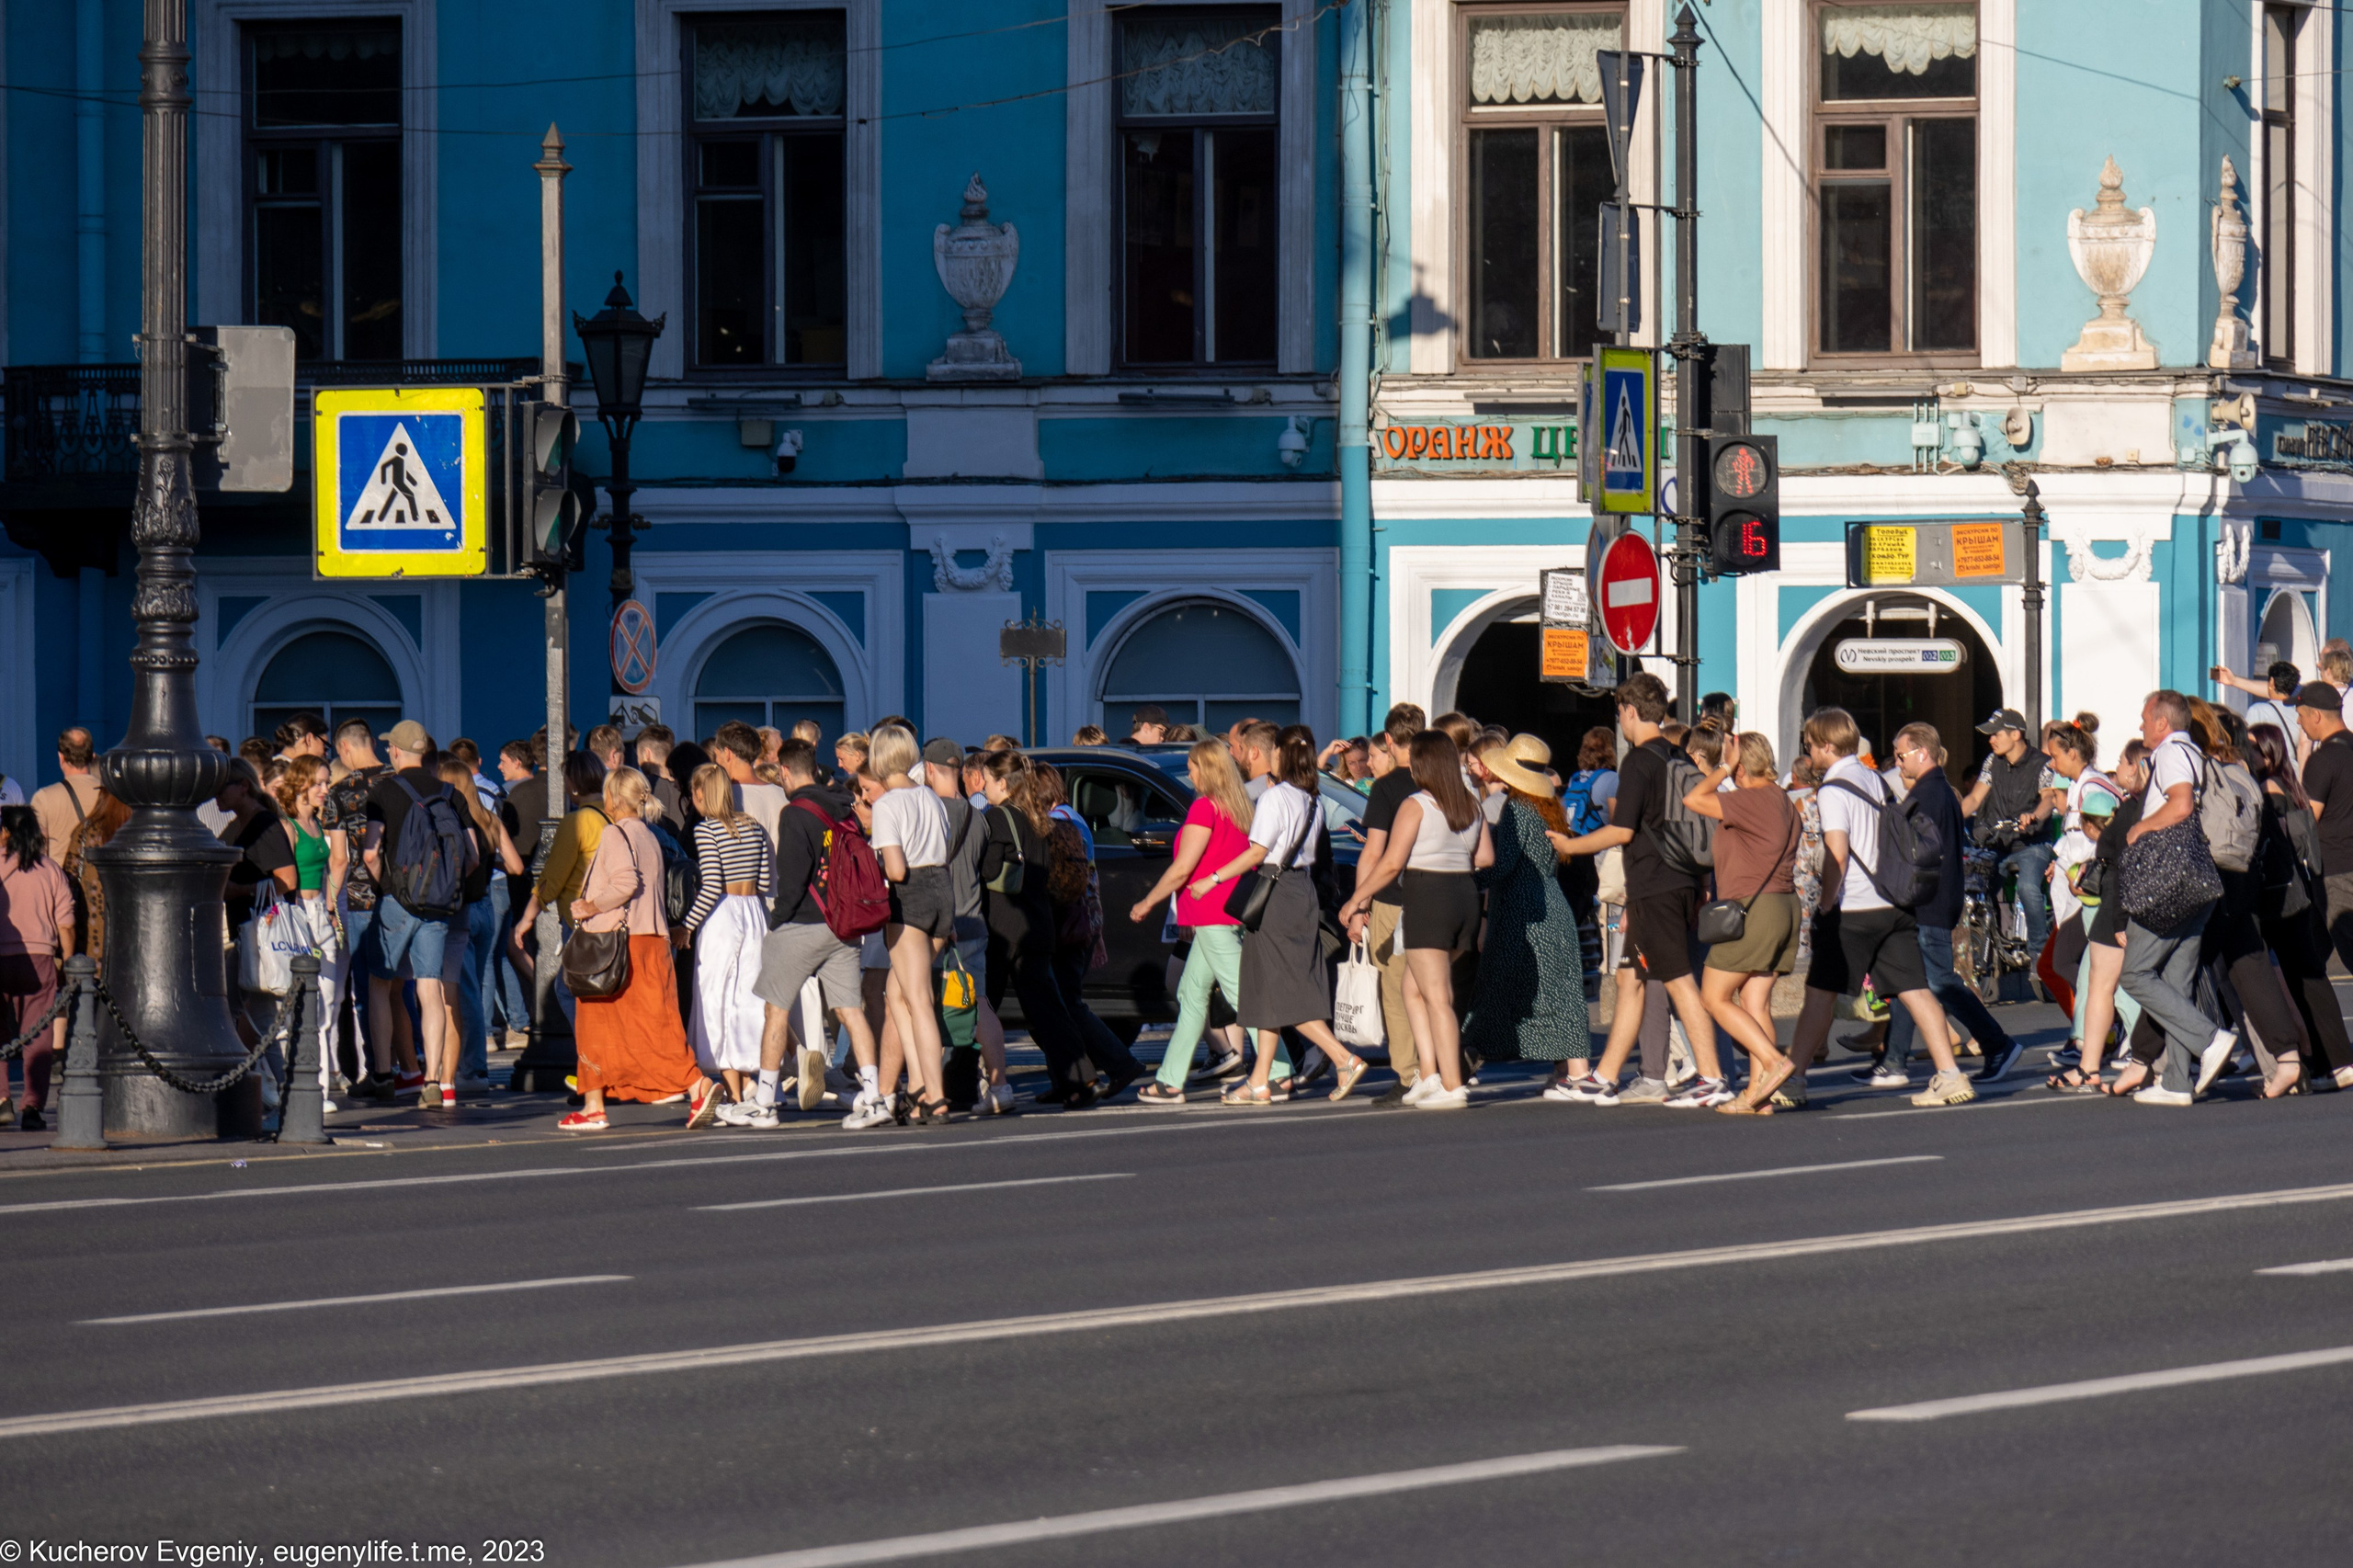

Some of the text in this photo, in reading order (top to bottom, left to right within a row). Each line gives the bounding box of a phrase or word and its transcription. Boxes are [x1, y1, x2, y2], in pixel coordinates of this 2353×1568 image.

[1383, 426, 1513, 460] ОРАНЖ
[1956, 535, 1998, 545] КРЫШАМ
[1547, 641, 1584, 649] КРЫШАМ
[1889, 648, 1920, 656] проспект
